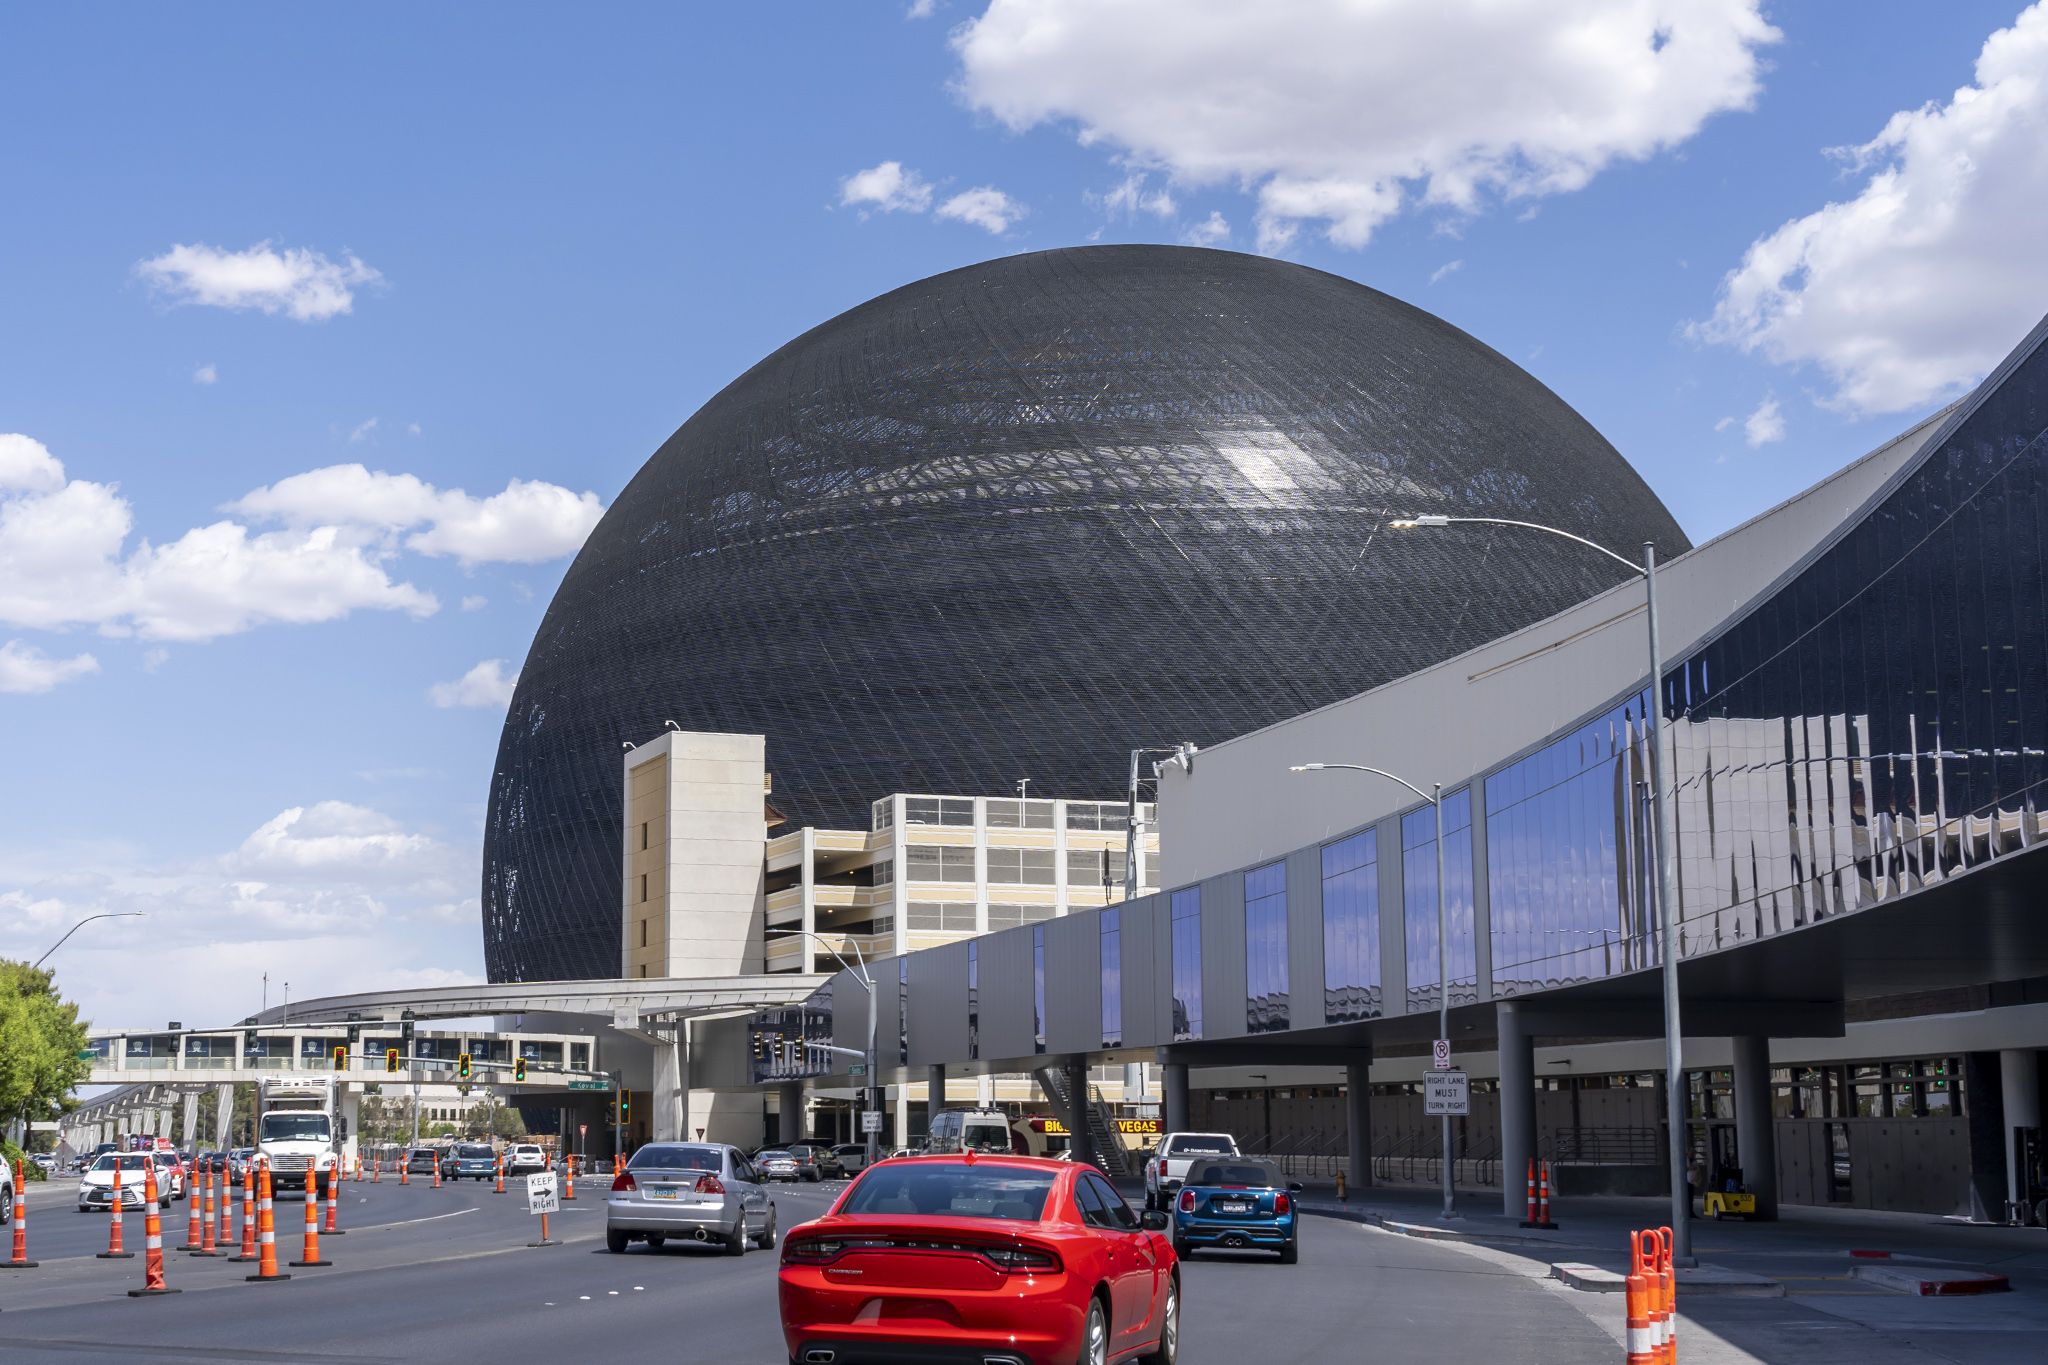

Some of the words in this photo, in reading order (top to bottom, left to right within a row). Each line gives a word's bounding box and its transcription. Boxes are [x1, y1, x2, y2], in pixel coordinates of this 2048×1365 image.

[1448, 1077, 1465, 1085] LANE
[1435, 1089, 1458, 1098] MUST
[1428, 1101, 1445, 1109] TURN
[1447, 1102, 1466, 1110] RIGHT
[1118, 1120, 1157, 1133] VEGAS
[531, 1176, 553, 1187] KEEP
[533, 1199, 555, 1210] RIGHT
